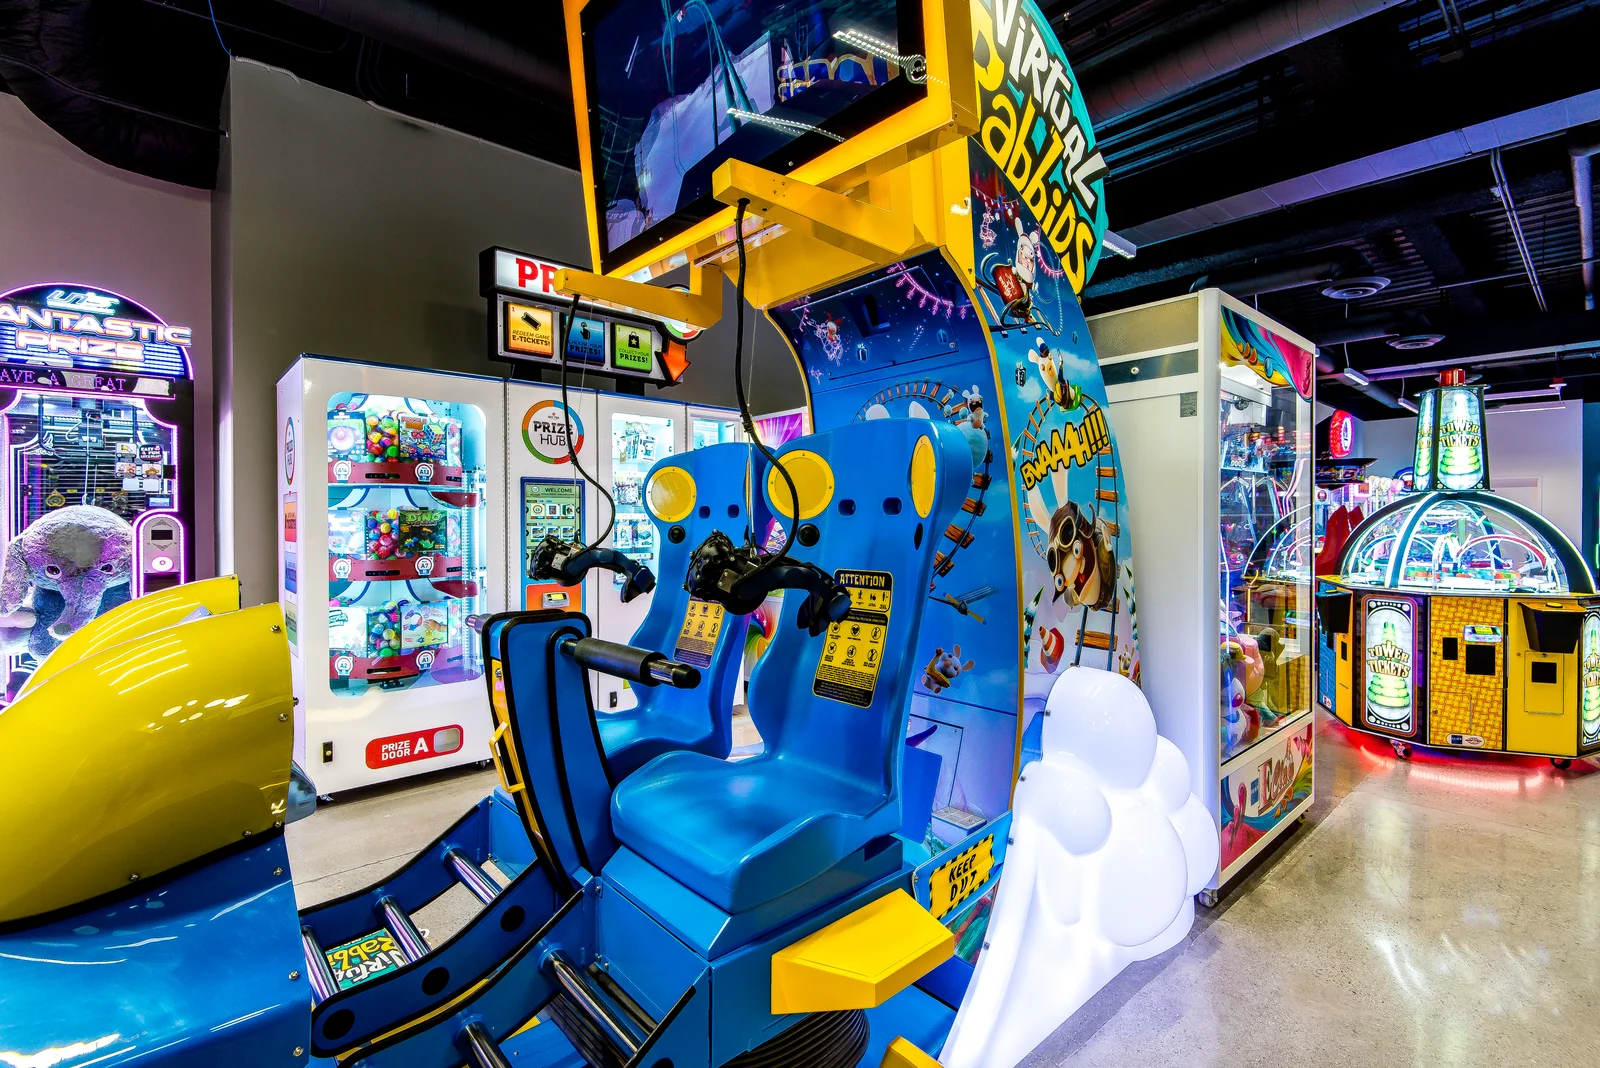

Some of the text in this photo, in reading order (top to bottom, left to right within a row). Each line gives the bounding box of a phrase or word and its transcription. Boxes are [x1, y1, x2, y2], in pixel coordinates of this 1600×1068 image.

[990, 0, 1108, 210] VIRTUAL
[0, 304, 192, 346] ANTASTIC
[16, 329, 145, 361] PRIZE
[512, 334, 551, 346] E-TICKETS!
[569, 345, 601, 356] PRIZES!
[619, 353, 648, 363] PRIZES!
[0, 368, 36, 384] AVE
[70, 374, 127, 392] GREAT
[1439, 416, 1480, 434] TOWER
[1438, 434, 1480, 447] TICKETS
[840, 573, 885, 588] ATTENTION
[1367, 640, 1410, 663] TOWER
[1366, 659, 1411, 678] TICKETS
[381, 739, 411, 753] PRIZE
[381, 748, 411, 761] DOOR
[413, 736, 429, 755] A
[949, 853, 977, 883] KEEP
[950, 869, 978, 902] OUT
[327, 937, 398, 971] Rabbi
[333, 950, 406, 983] VIRTUA
